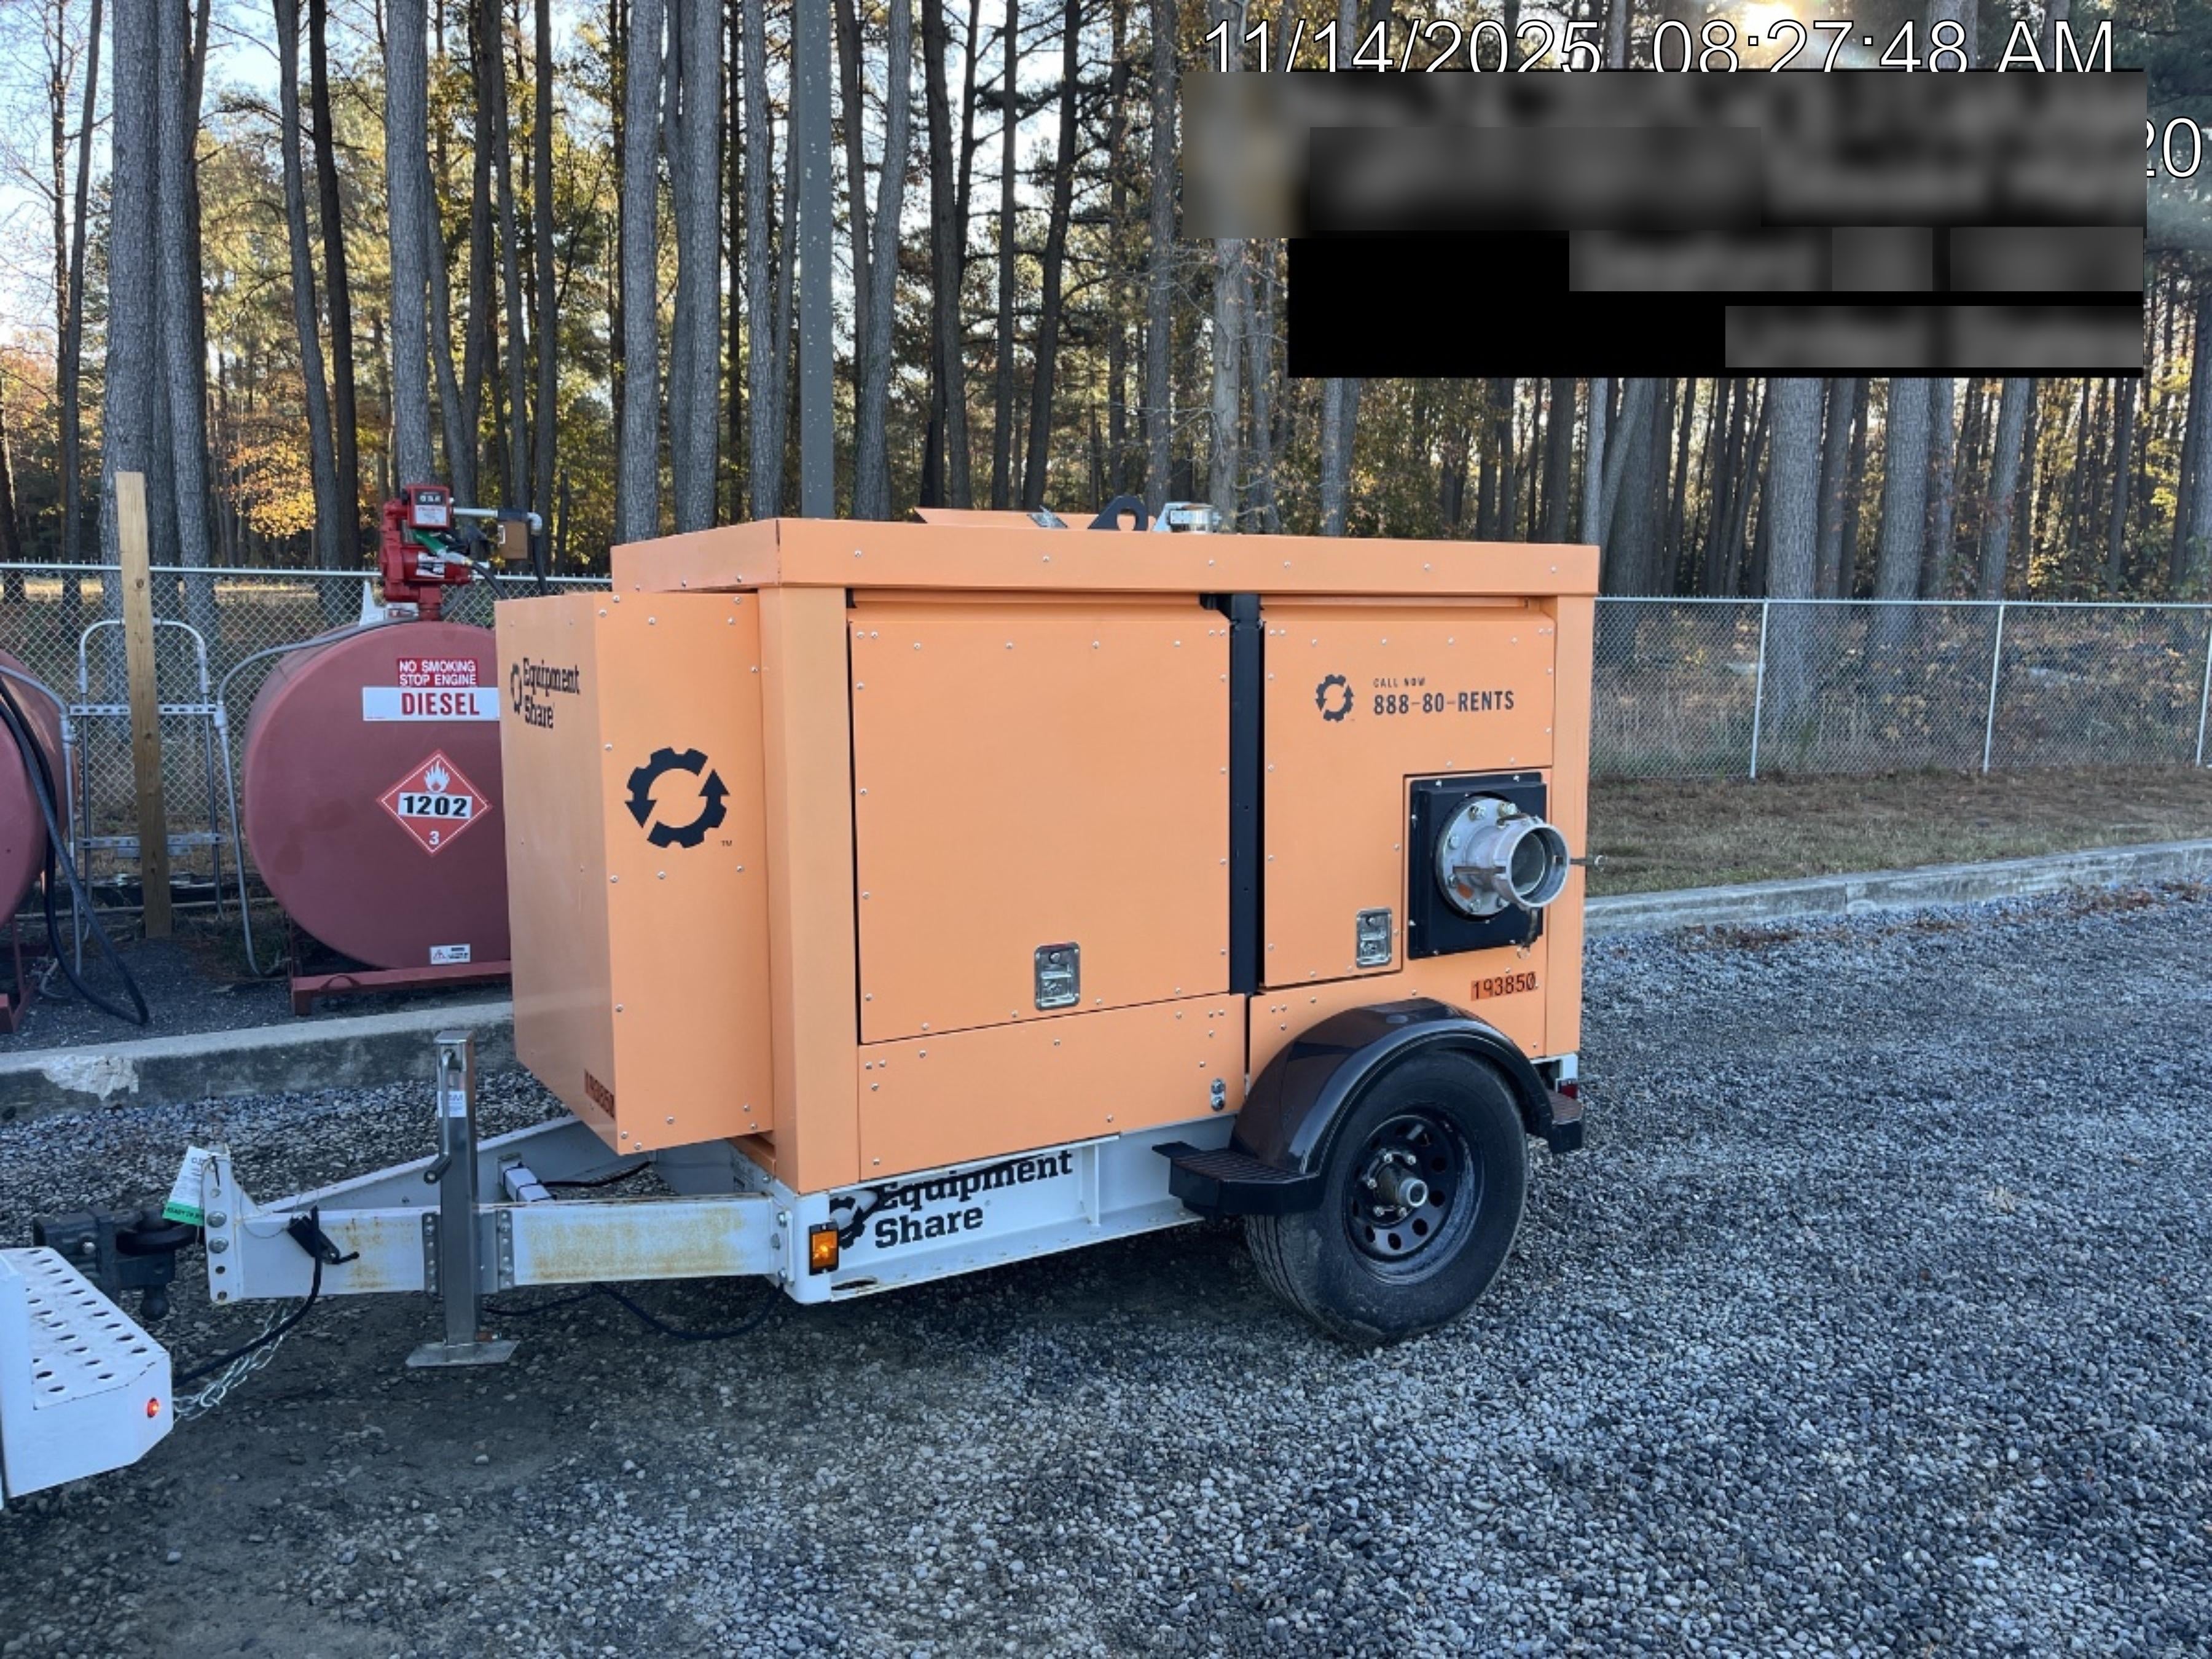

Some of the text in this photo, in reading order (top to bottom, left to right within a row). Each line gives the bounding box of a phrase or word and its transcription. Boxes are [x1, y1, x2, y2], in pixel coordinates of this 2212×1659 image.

[399, 659, 476, 673] NO SMOKING
[523, 657, 580, 697] Equipment
[399, 674, 477, 686] STOP ENGINE
[1373, 677, 1426, 688] CALL NOW
[401, 692, 480, 716] DIESEL
[525, 694, 554, 729] Share
[1373, 691, 1515, 716] 888-80-RENTS
[402, 795, 468, 817] 1202
[429, 830, 440, 845] 3
[1473, 971, 1537, 1000] 193850
[875, 1150, 1073, 1212] Equipment
[875, 1207, 984, 1249] Share
